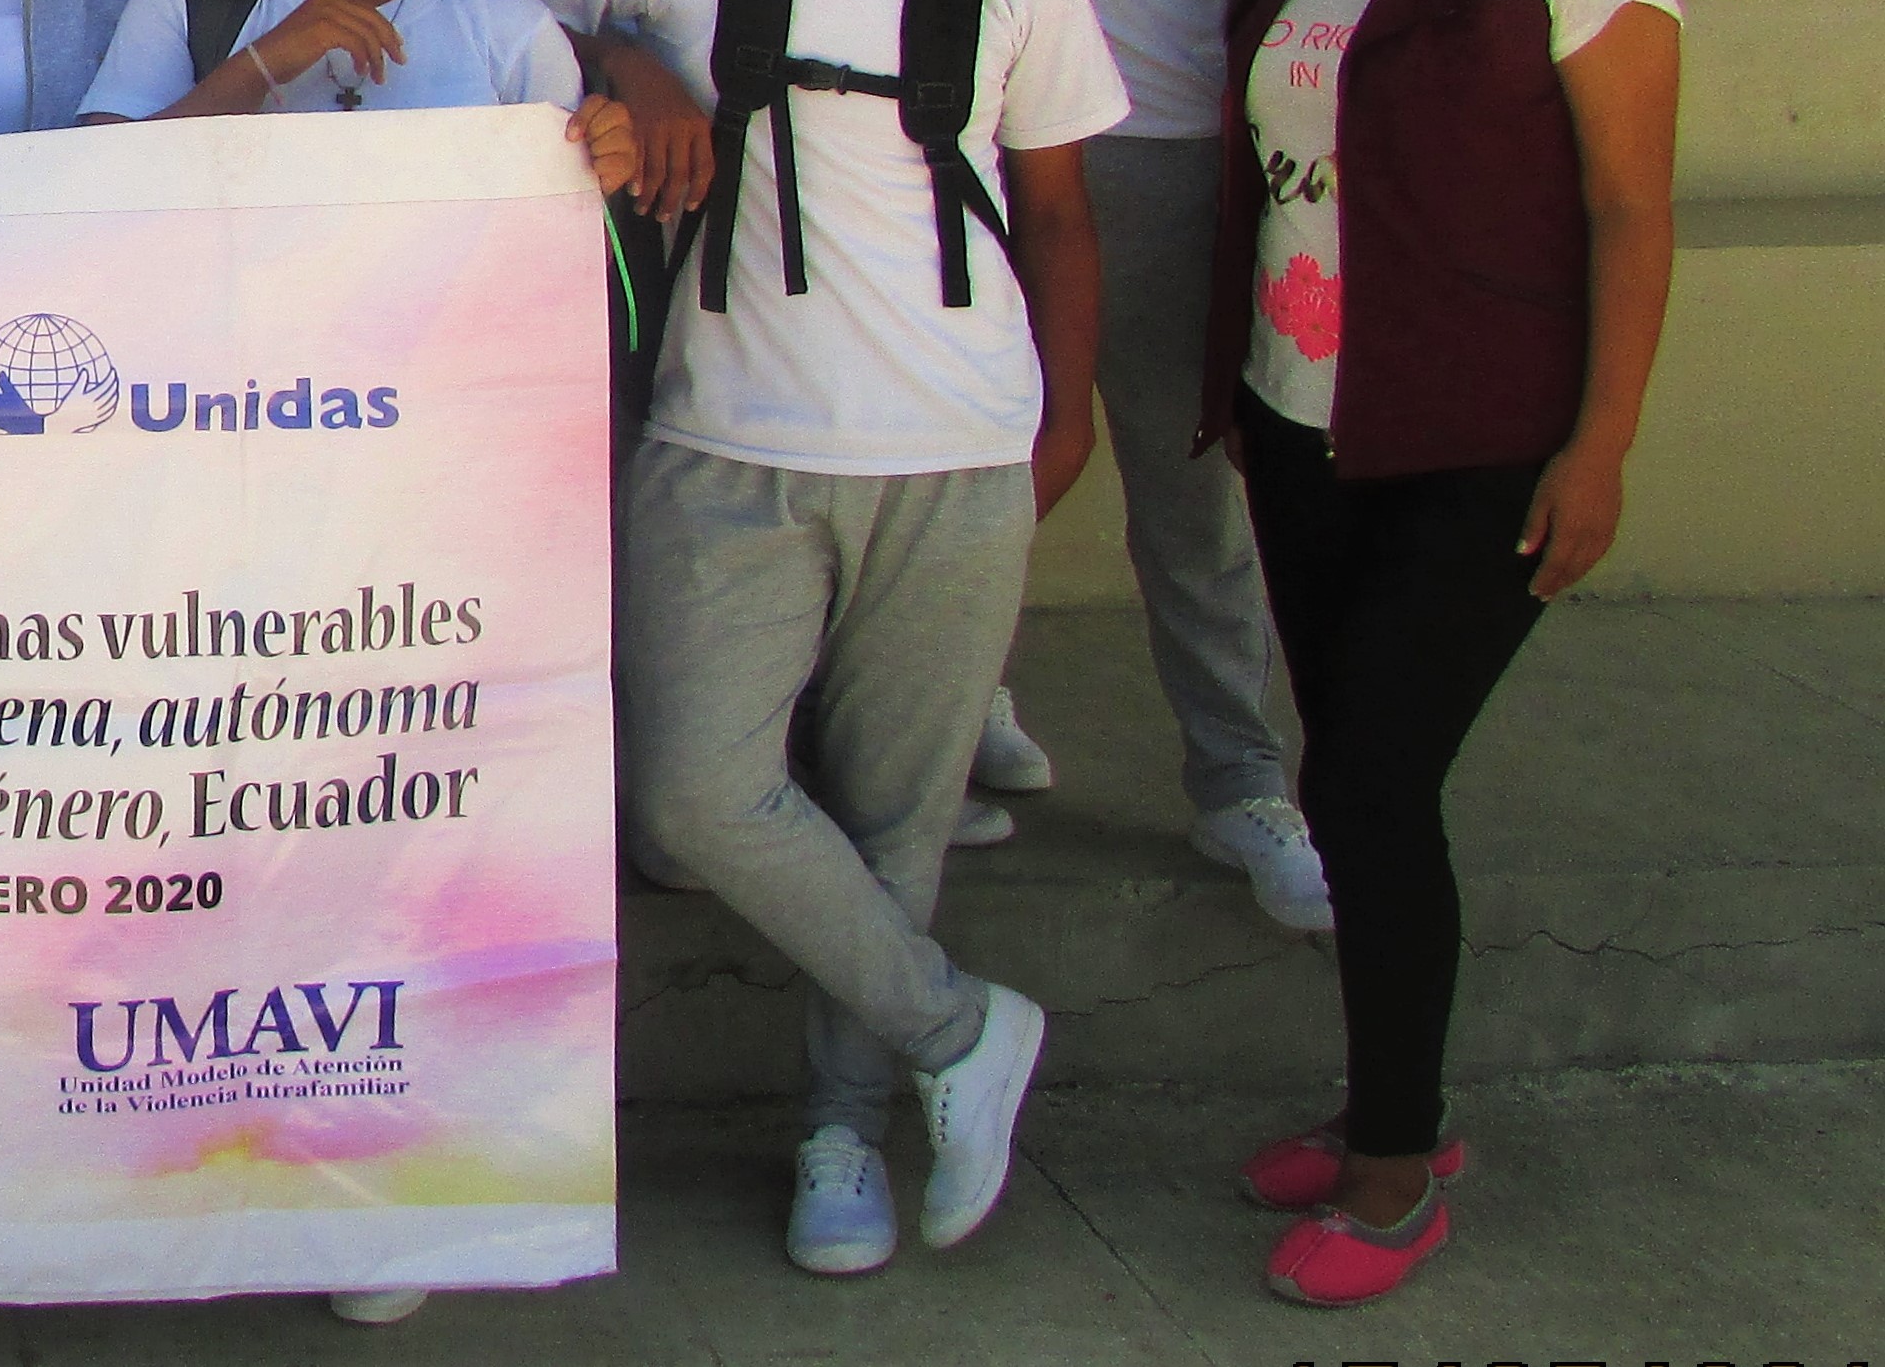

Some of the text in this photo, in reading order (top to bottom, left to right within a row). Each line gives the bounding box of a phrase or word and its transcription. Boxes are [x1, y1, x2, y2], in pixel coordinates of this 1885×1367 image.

[1290, 60, 1321, 89] IN
[130, 377, 400, 433] Unidas
[97, 582, 482, 661] vulnerables
[138, 677, 480, 748] autónoma
[189, 752, 479, 839] Ecuador
[104, 871, 223, 914] 2020
[67, 980, 405, 1073] UMAVI
[58, 1077, 411, 1114] de la Violencia Intrafamiliar
[60, 1054, 403, 1094] Unidad Modelo de Atención
